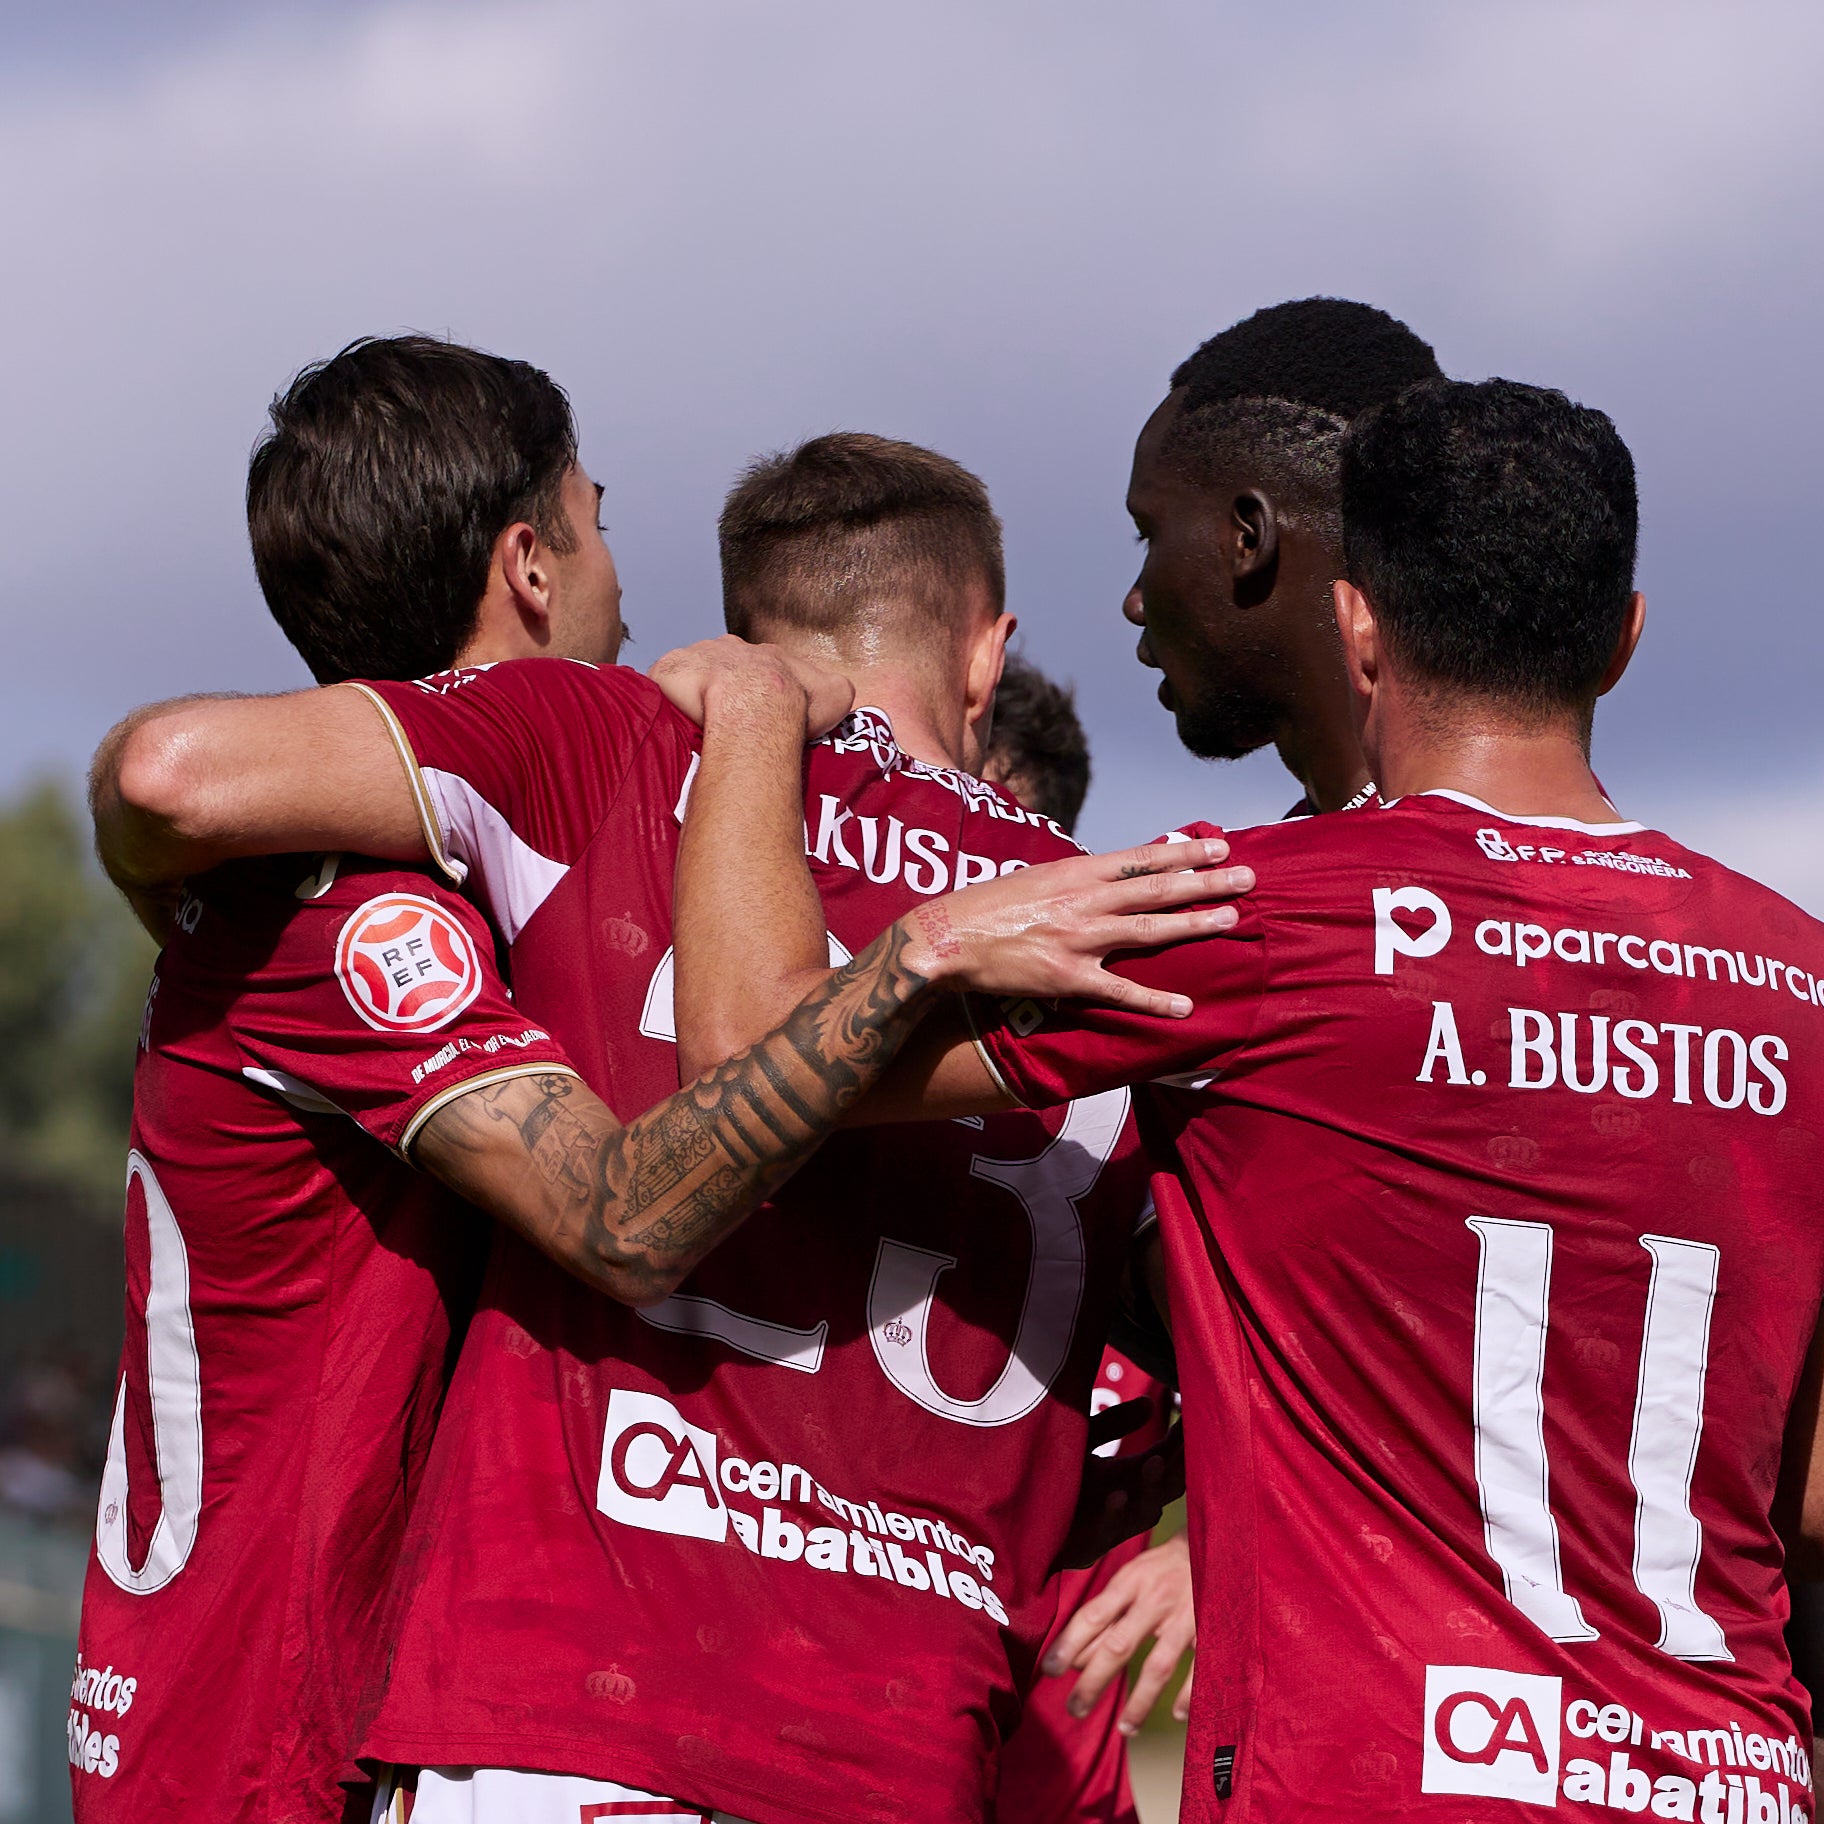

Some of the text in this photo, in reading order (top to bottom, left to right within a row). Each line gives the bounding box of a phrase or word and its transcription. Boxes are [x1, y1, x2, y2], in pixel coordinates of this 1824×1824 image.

[1571, 856, 1693, 879] SANGONERA
[410, 1064, 426, 1085] DE
[1416, 1001, 1790, 1116] A. BUSTOS
[611, 1421, 719, 1510] CA
[1464, 1215, 1736, 1662] 11
[727, 1507, 1010, 1627] abatibles
[1434, 1690, 1550, 1775] CA
